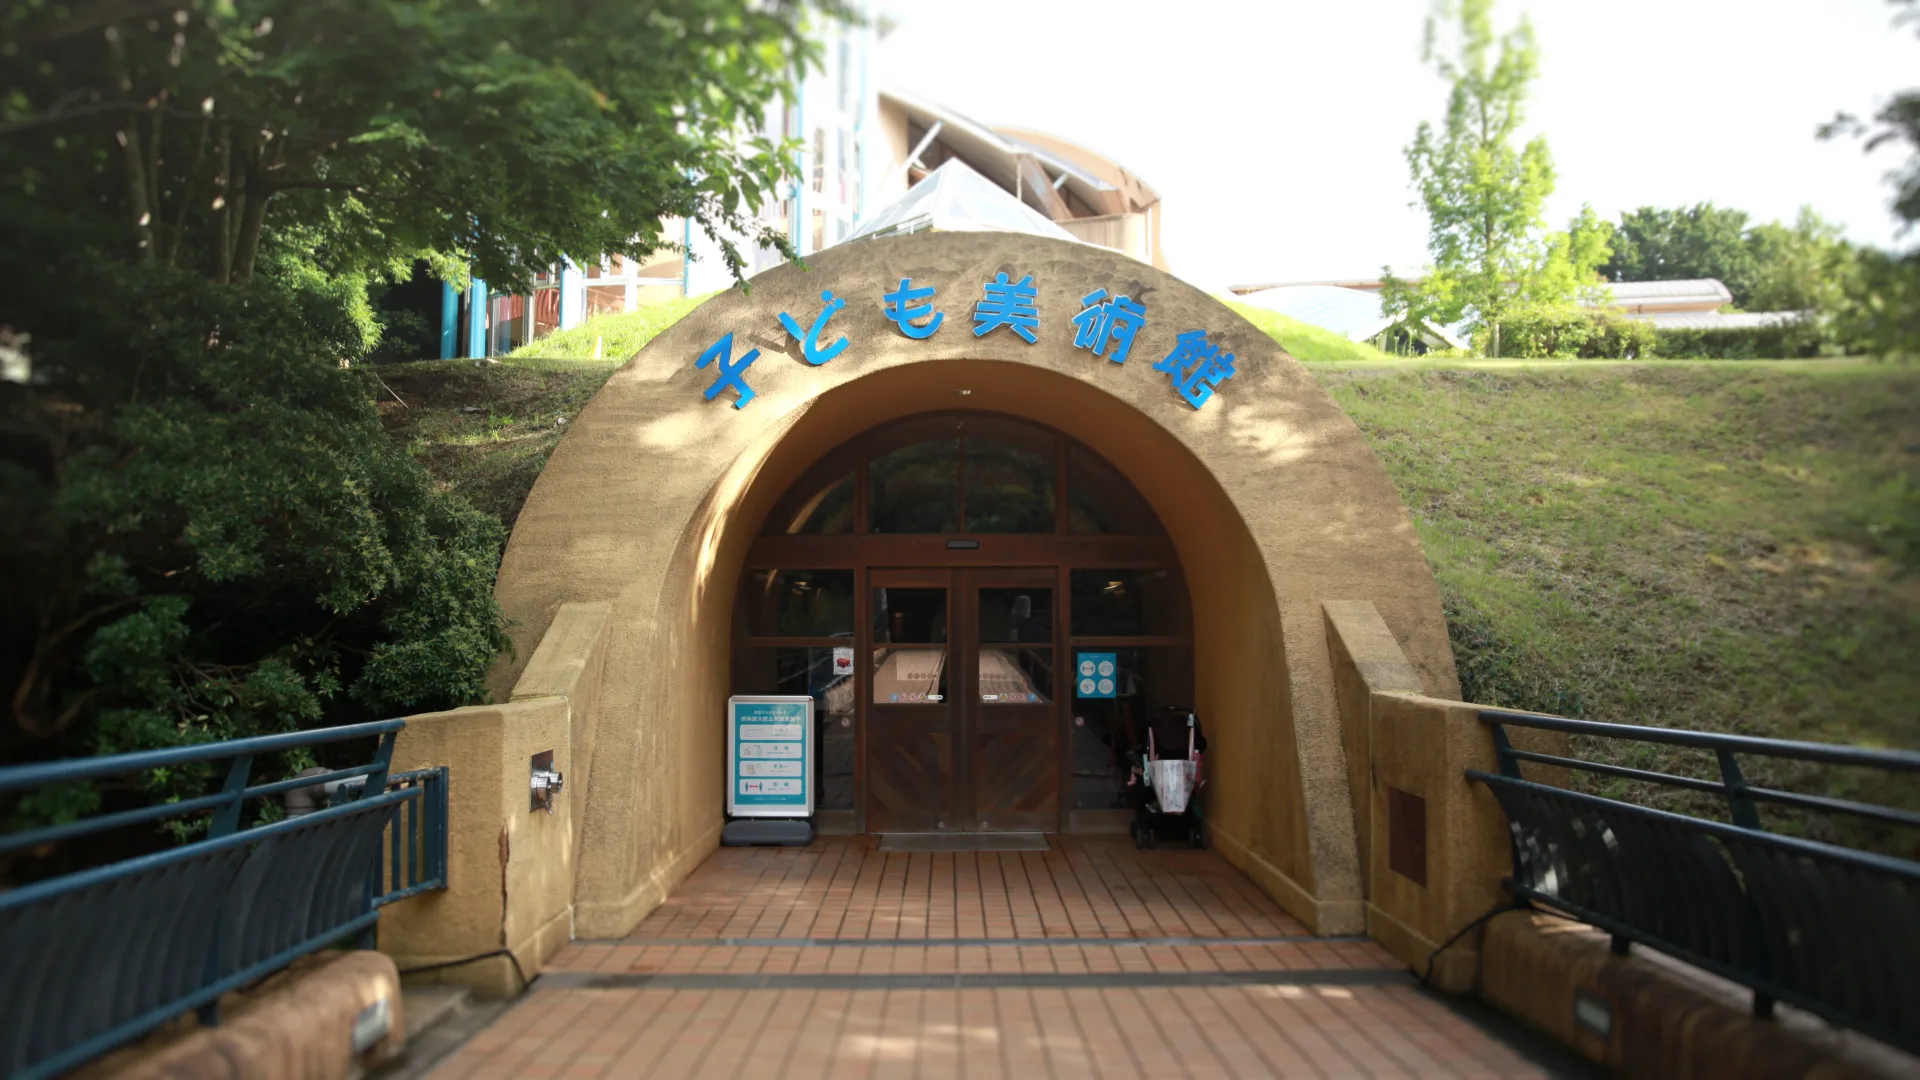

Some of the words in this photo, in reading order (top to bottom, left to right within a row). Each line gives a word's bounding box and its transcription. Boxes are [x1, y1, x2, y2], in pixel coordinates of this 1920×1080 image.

[695, 273, 1237, 410] 子ども美術館
